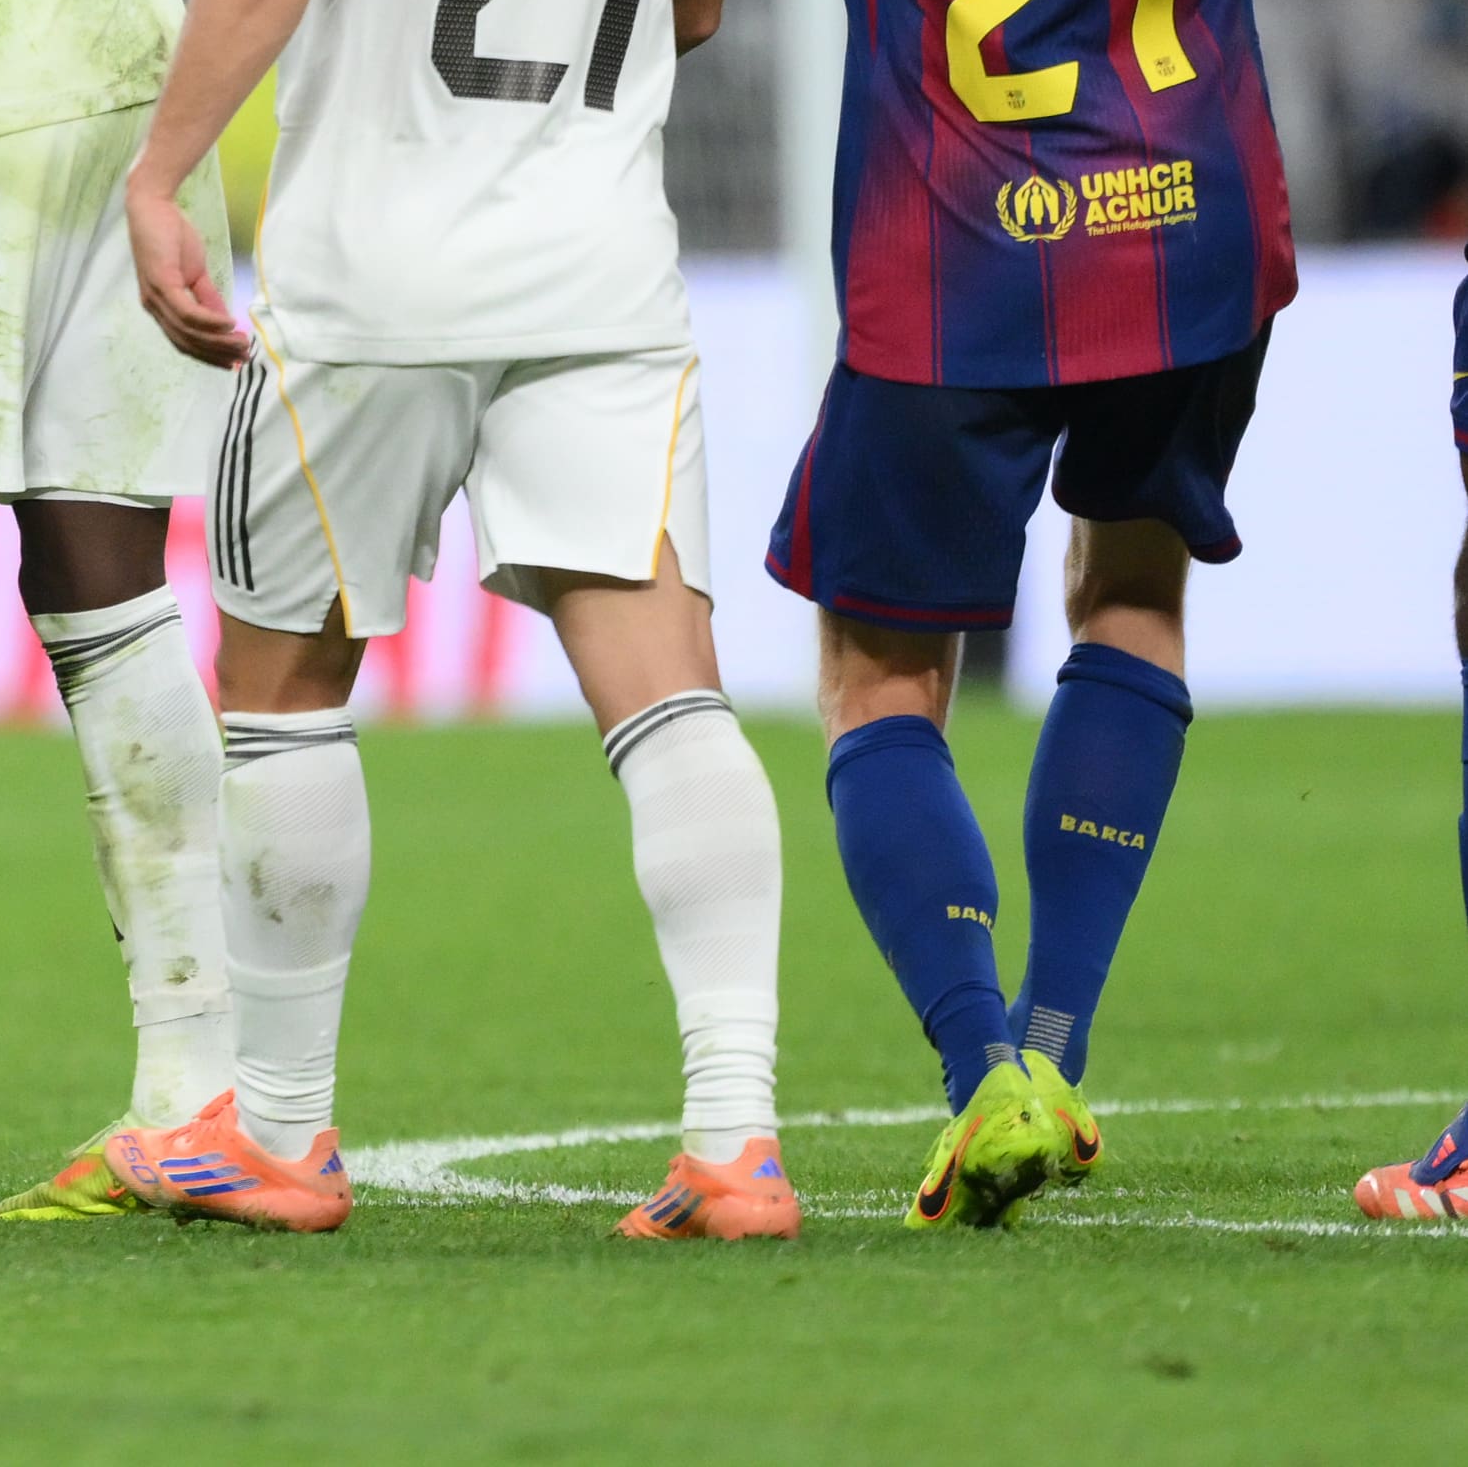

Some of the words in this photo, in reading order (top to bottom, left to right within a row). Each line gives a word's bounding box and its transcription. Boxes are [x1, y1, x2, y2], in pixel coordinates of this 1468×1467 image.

[1080, 160, 1194, 200] UNHCR
[1085, 184, 1196, 226] ACNUR
[1087, 226, 1105, 237] The
[1106, 222, 1122, 235] UN
[1122, 217, 1162, 232] Refugee
[1163, 211, 1198, 226] Agency
[1060, 814, 1146, 850] BARÇA
